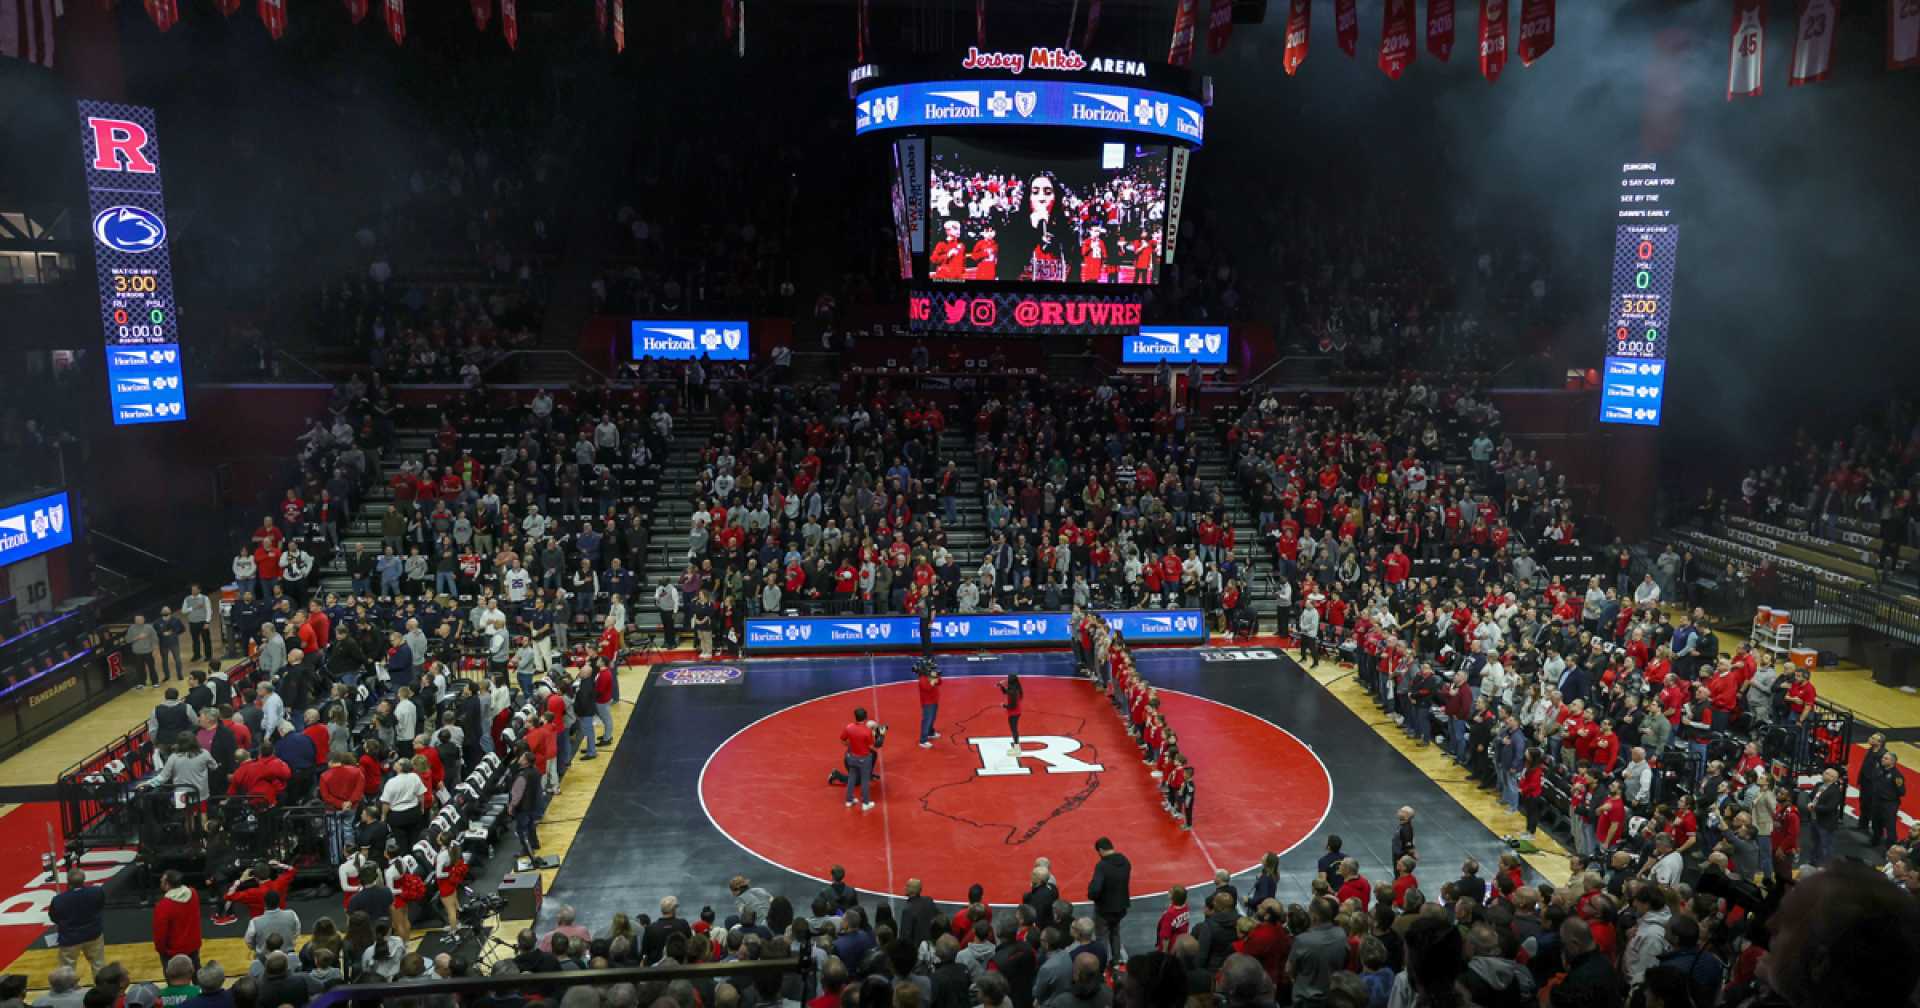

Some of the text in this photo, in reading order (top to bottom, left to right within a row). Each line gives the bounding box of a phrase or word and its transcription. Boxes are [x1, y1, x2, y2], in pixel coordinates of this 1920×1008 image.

[1738, 33, 1757, 57] 45
[963, 46, 1146, 76] Jersey Mike's ARENA
[925, 104, 981, 119] Horizon
[1072, 104, 1130, 122] Horizon
[88, 117, 155, 173] R
[1639, 241, 1652, 259] 0
[115, 276, 156, 292] 3:00
[1636, 271, 1649, 289] 0
[1622, 300, 1657, 313] 3:00
[114, 309, 163, 324] 0 0
[1616, 327, 1657, 342] 0 0
[643, 337, 696, 350] Horizon
[1133, 341, 1180, 353] Horizon
[966, 735, 1105, 776] R
